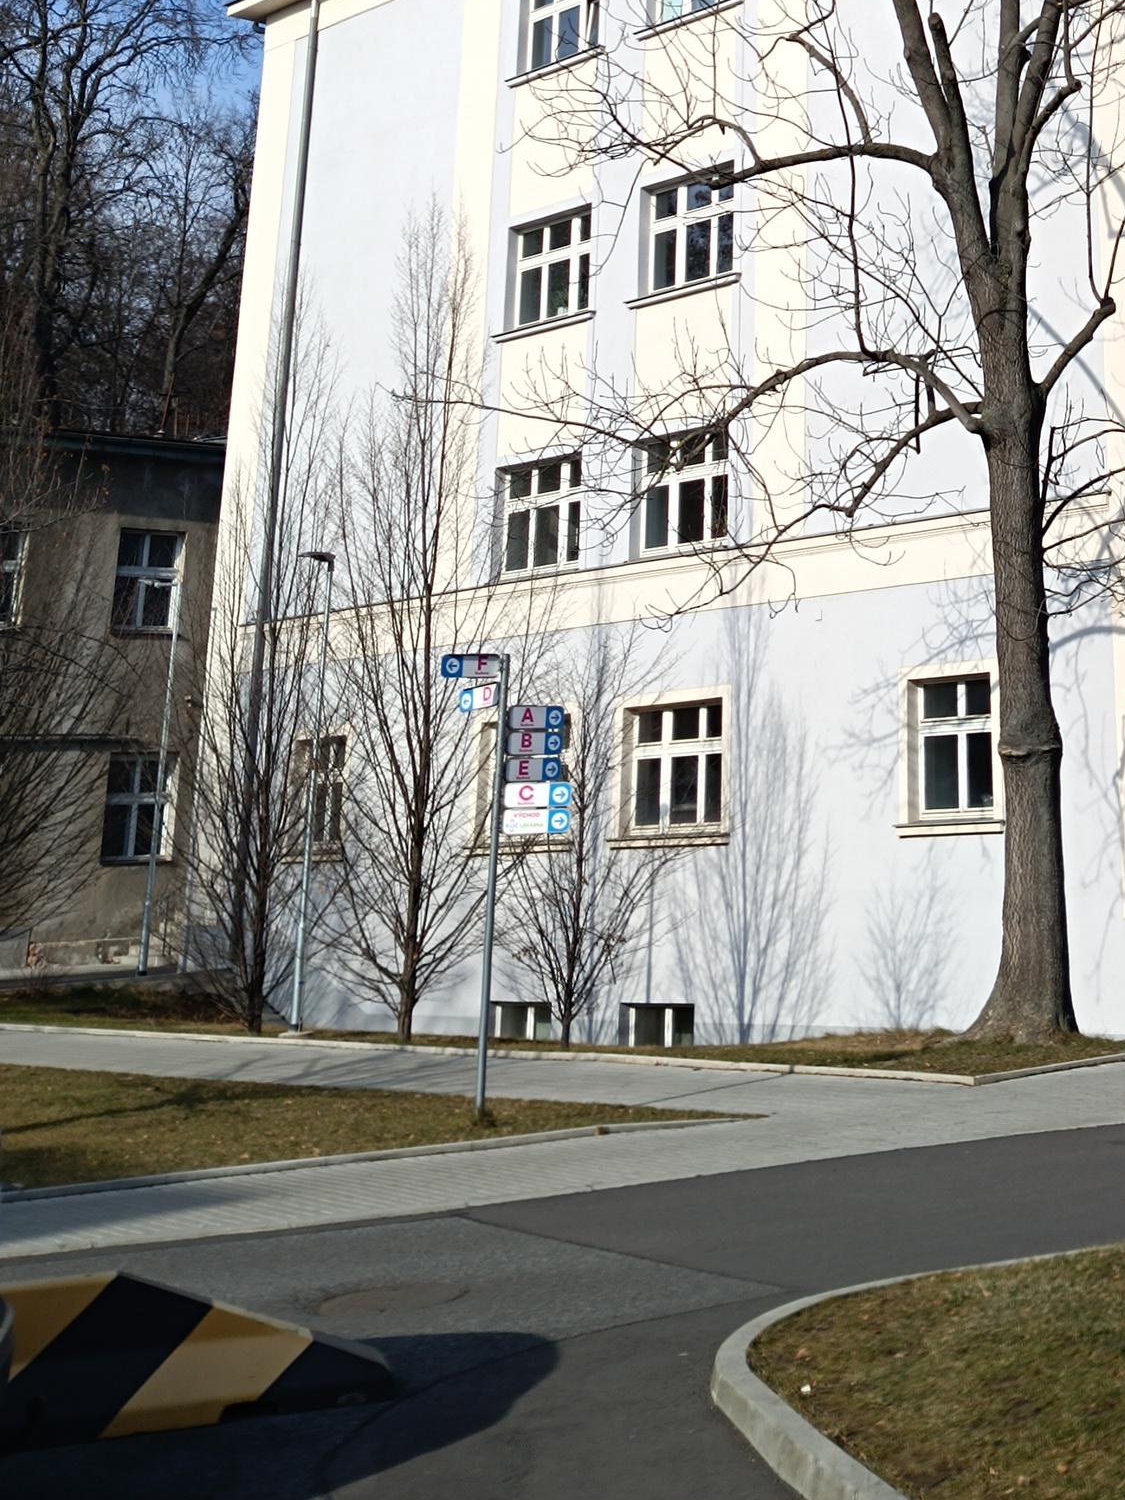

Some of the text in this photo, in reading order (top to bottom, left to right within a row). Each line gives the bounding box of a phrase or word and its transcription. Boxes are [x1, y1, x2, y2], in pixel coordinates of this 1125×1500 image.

[477, 655, 489, 671] F
[483, 686, 492, 701] D
[521, 707, 534, 722] A
[521, 733, 533, 748] B
[518, 761, 529, 776] E
[519, 785, 534, 801] C
